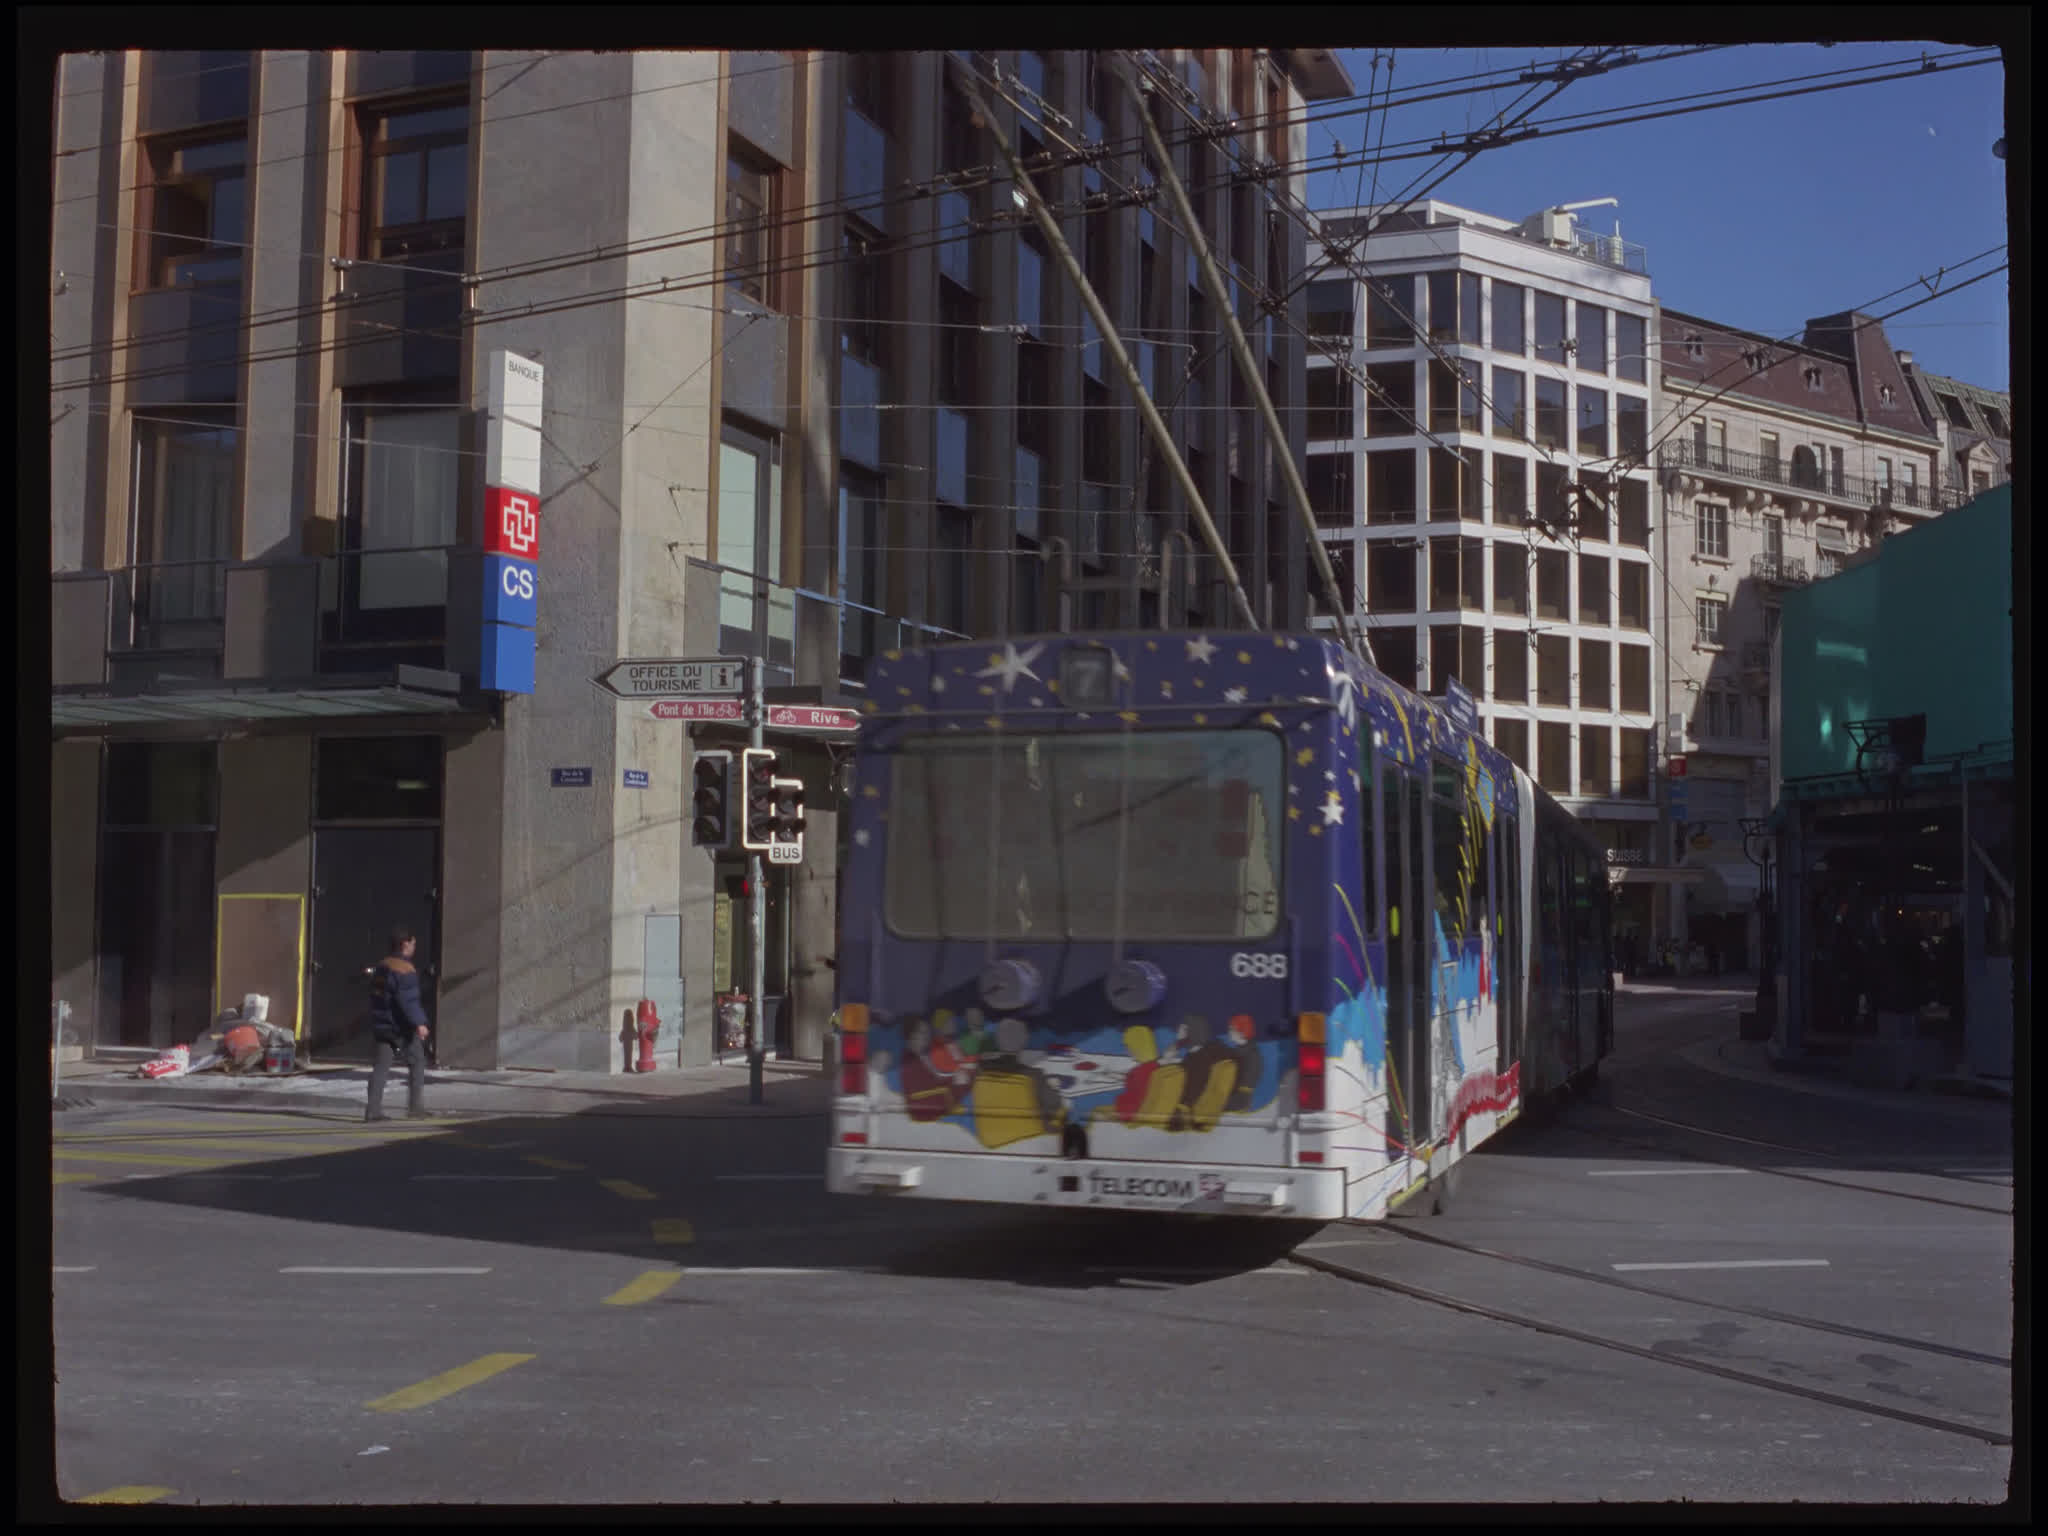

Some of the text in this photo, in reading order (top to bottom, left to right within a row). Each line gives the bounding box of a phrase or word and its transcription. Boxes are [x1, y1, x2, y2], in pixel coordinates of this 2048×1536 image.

[508, 360, 540, 382] BANQUE
[503, 566, 533, 599] CS
[630, 666, 677, 678] OFFICE
[683, 665, 702, 678] DU
[632, 679, 701, 691] TOURISME
[658, 703, 679, 716] Pont
[682, 703, 695, 716] de
[810, 710, 840, 724] Rive
[773, 848, 800, 859] BUS
[1231, 953, 1288, 978] 688
[1089, 1175, 1192, 1198] TELECOM
